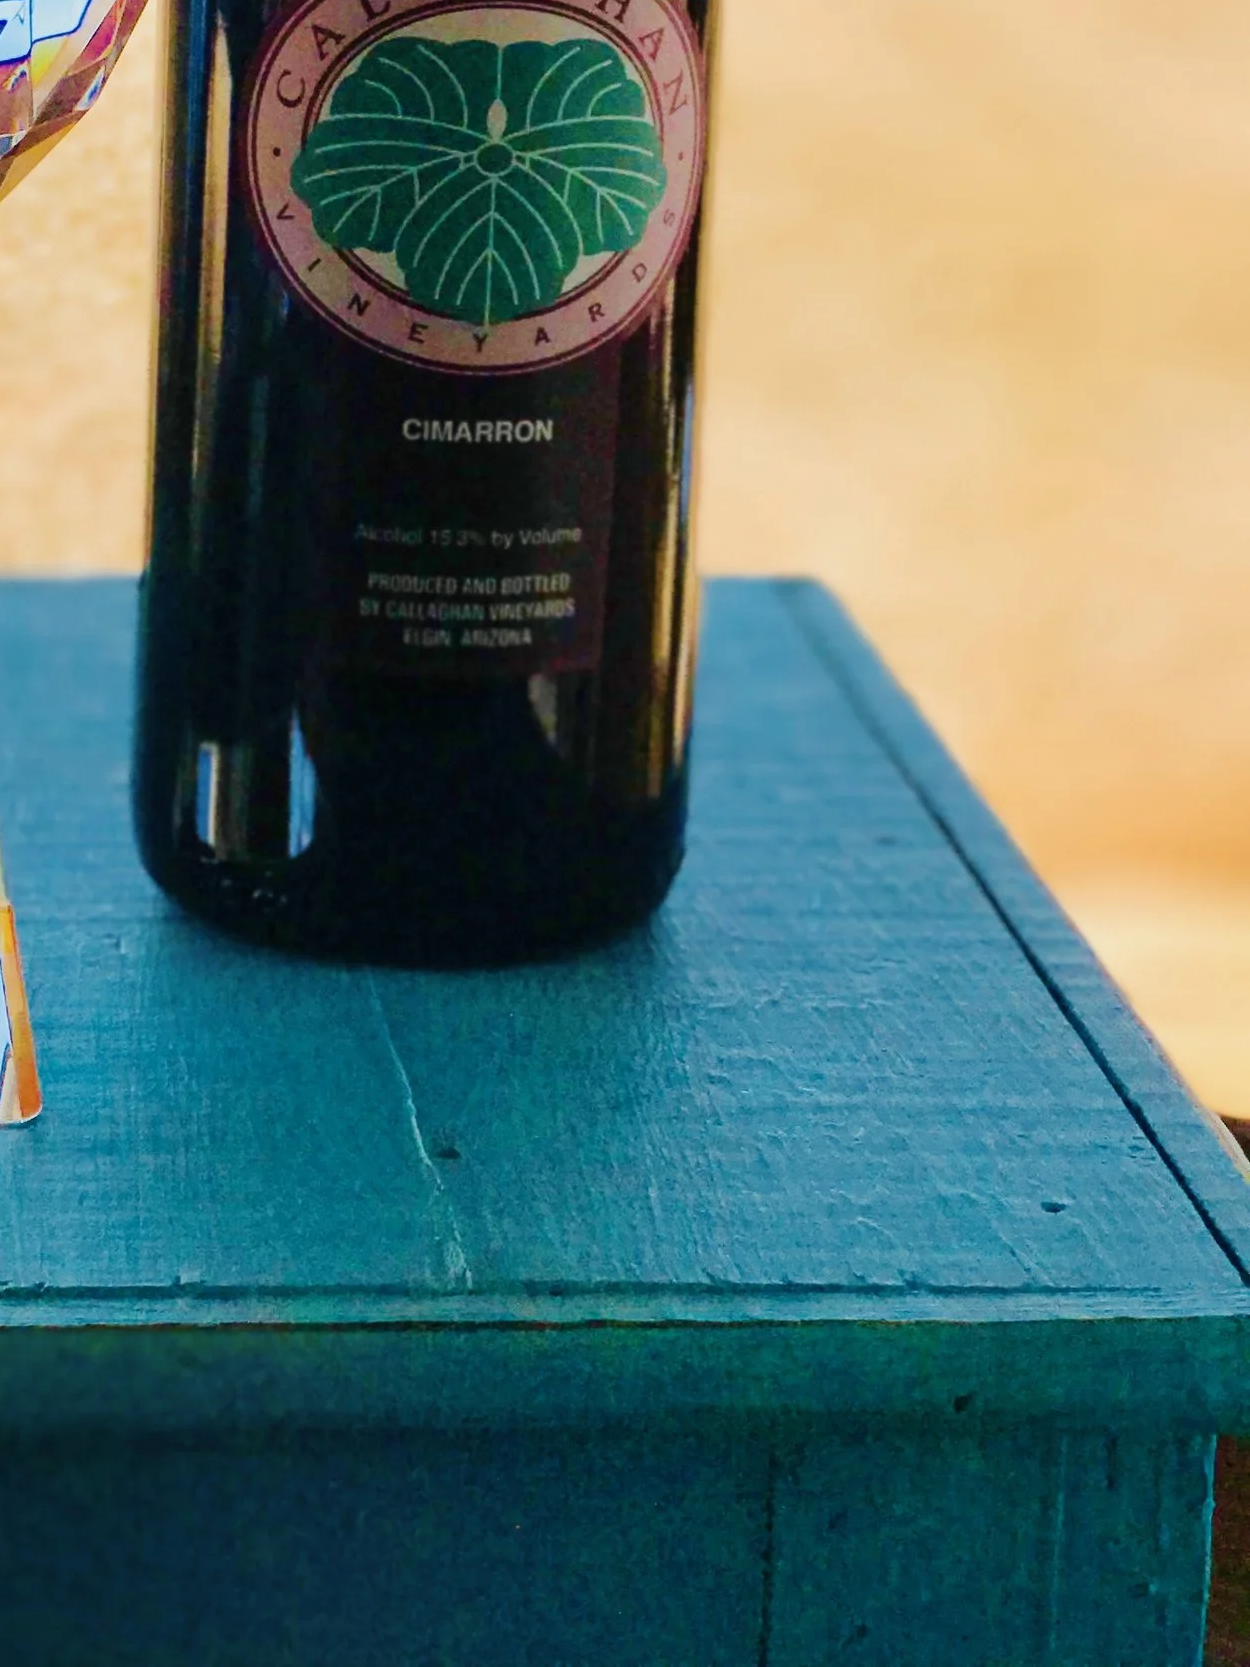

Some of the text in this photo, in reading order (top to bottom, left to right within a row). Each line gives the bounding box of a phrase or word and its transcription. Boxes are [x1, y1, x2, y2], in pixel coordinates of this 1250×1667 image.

[276, 203, 677, 353] VINEYARDS
[403, 419, 554, 443] CIMARRON
[491, 530, 514, 549] by
[518, 526, 583, 546] Volume
[367, 572, 571, 595] PRODUCED AND BOTTLED
[359, 598, 575, 621] BY CALLAGHAN VINEYARDS
[461, 628, 533, 647] ARIZONA
